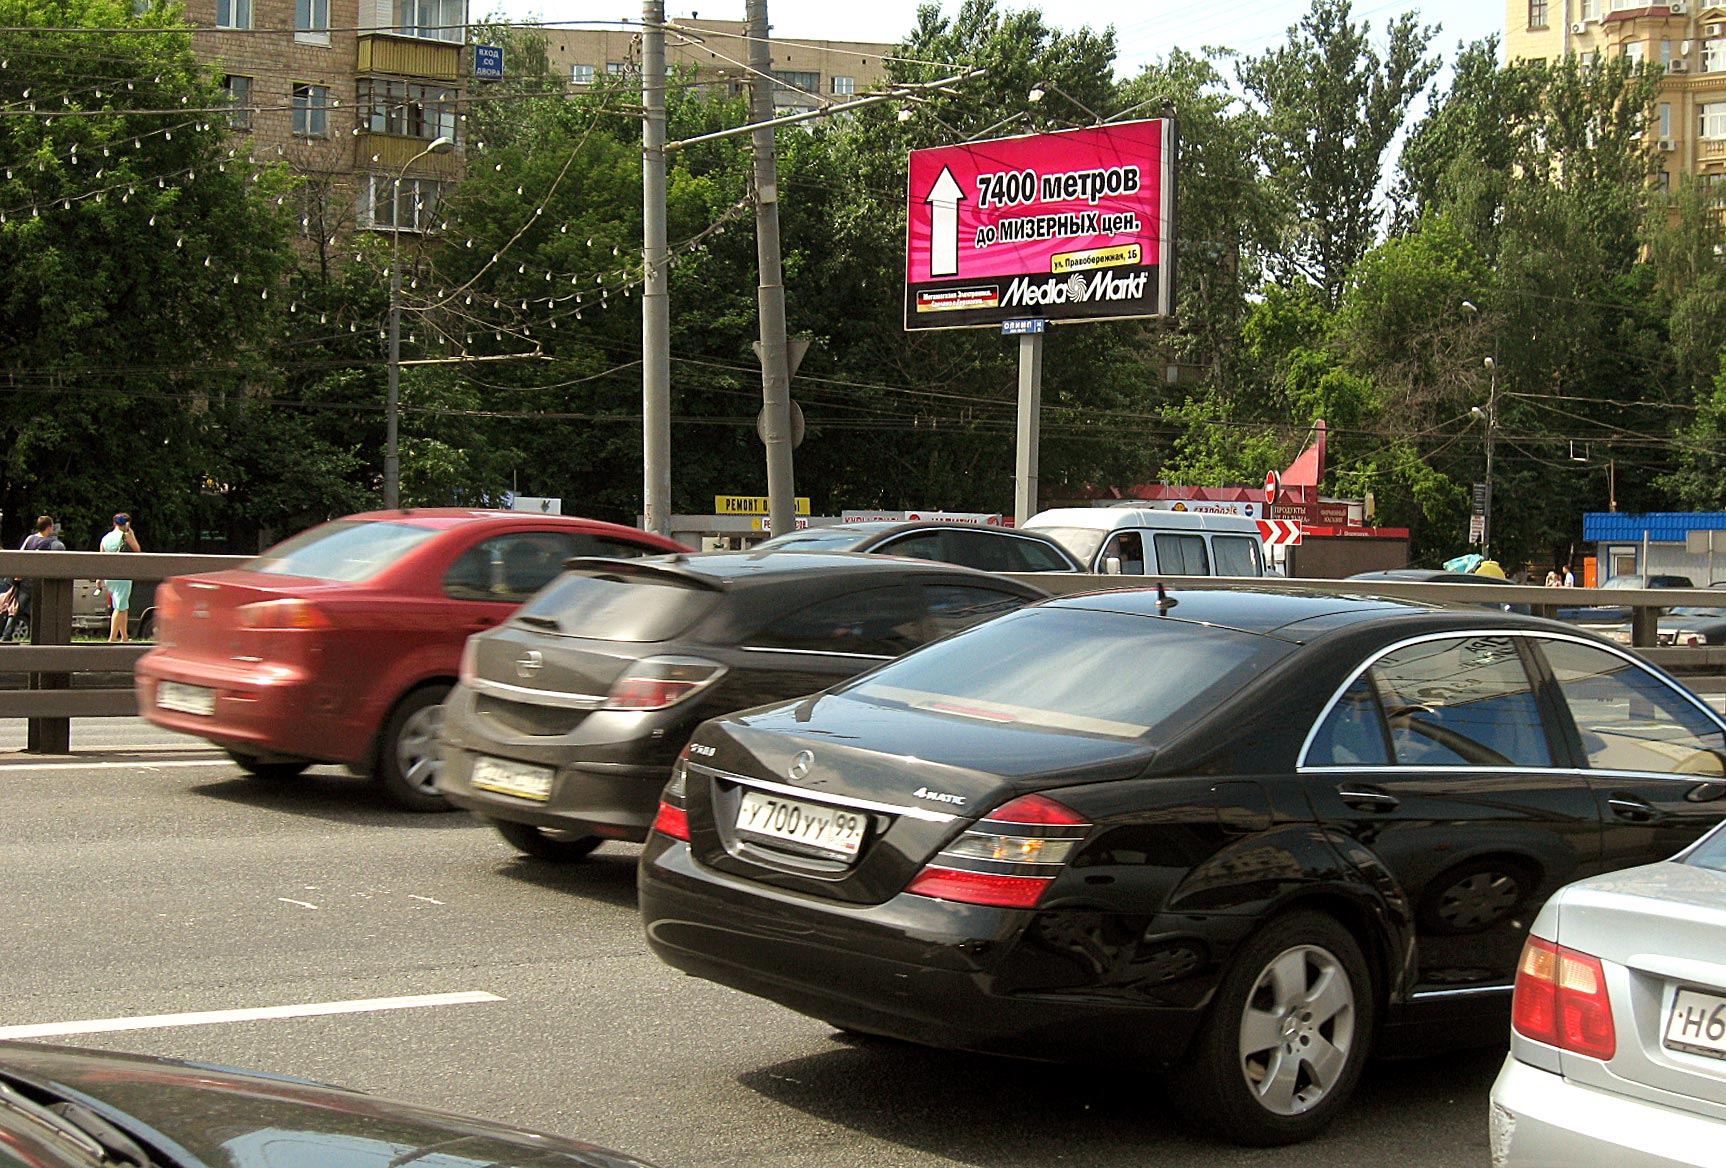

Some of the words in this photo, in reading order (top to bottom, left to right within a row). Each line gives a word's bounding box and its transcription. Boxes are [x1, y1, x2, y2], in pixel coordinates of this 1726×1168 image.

[478, 49, 499, 58] ВХОД
[476, 67, 500, 76] ДВОРА
[977, 170, 1037, 207] 7400
[1042, 167, 1138, 203] метров
[976, 227, 995, 246] до
[1000, 212, 1099, 241] МИЗЕРНЫХ
[1102, 214, 1140, 235] цен.
[1000, 275, 1067, 308] Media
[1083, 270, 1147, 302] Markt
[726, 499, 757, 511] РЕМОНТ
[836, 813, 857, 838] 99
